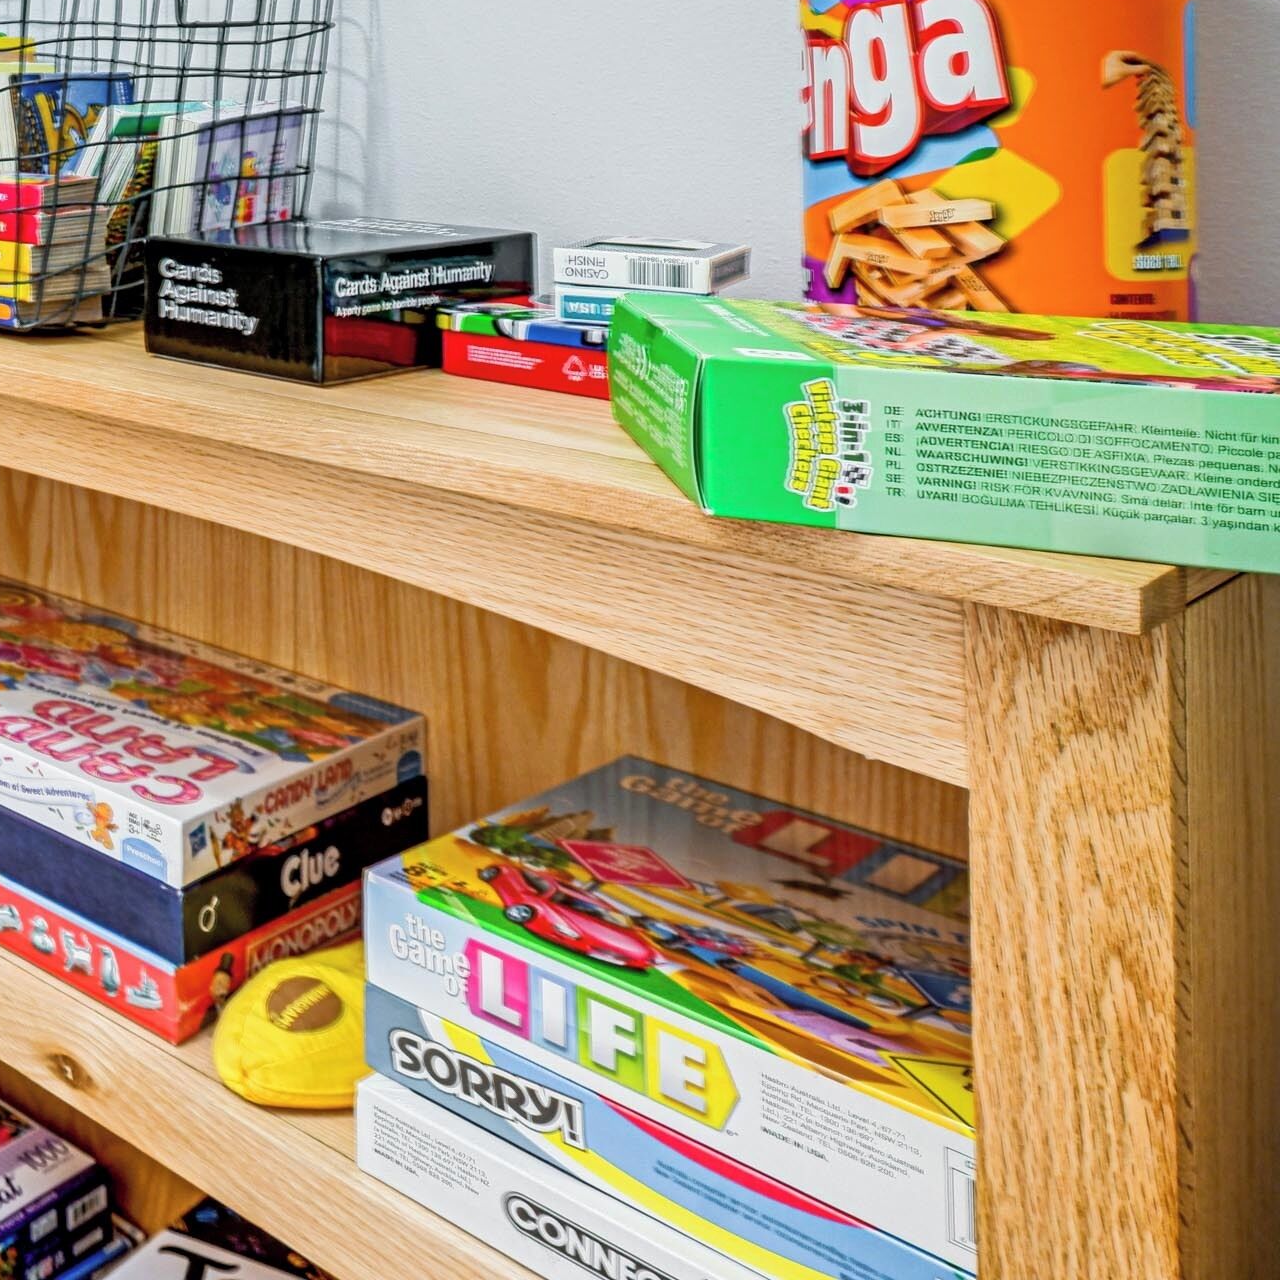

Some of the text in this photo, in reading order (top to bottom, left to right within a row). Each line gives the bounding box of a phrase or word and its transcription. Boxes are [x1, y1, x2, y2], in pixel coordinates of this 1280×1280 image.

[158, 258, 223, 284] Cards
[335, 261, 495, 298] Cards Against Humanity
[564, 265, 609, 280] CASINO
[568, 254, 606, 268] FINISH
[158, 279, 239, 308] Against
[158, 299, 260, 336] Humanity
[842, 400, 865, 463] 3-in-1
[915, 408, 981, 422] ACHTUNG!
[1205, 429, 1237, 442] Nicht
[1240, 431, 1258, 443] für
[915, 422, 1003, 438] AVVERTENZA!
[1007, 429, 1074, 443] PERICOLO
[1078, 433, 1092, 444] DI
[1217, 445, 1263, 459] Piccole
[787, 403, 814, 491] Checkers
[805, 380, 841, 509] Vintage Giant
[916, 435, 1014, 452] ¡ADVERTENCIA!
[1018, 443, 1069, 457] RIESGO
[1072, 447, 1093, 459] DE
[1153, 454, 1195, 468] Piezas
[915, 449, 1029, 467] WAARSCHUWING!
[1194, 472, 1233, 486] Kleine
[916, 476, 977, 490] VARNING!
[981, 481, 1010, 494] RISK
[1190, 500, 1213, 513] Inte
[1217, 502, 1233, 514] för
[1237, 505, 1266, 518] barn
[916, 490, 958, 503] UYARI!
[1201, 516, 1209, 526] 3
[1212, 517, 1270, 533] yaşından
[33, 700, 240, 781] LAND
[21, 784, 44, 796] Sweet
[45, 786, 90, 802] Adventures
[264, 775, 313, 815] CANDY
[317, 758, 354, 795] LAND
[620, 775, 764, 830] Game
[665, 776, 729, 806] the
[281, 845, 341, 899] Clue
[759, 820, 942, 893] LI
[252, 902, 357, 972] MONOPOLY
[405, 913, 446, 951] the
[856, 914, 938, 942] SPIN
[390, 923, 471, 979] Game
[445, 975, 469, 1006] of
[479, 950, 708, 1115] LIFE
[394, 1032, 584, 1144] SORRY!
[17, 1136, 72, 1172] 1000
